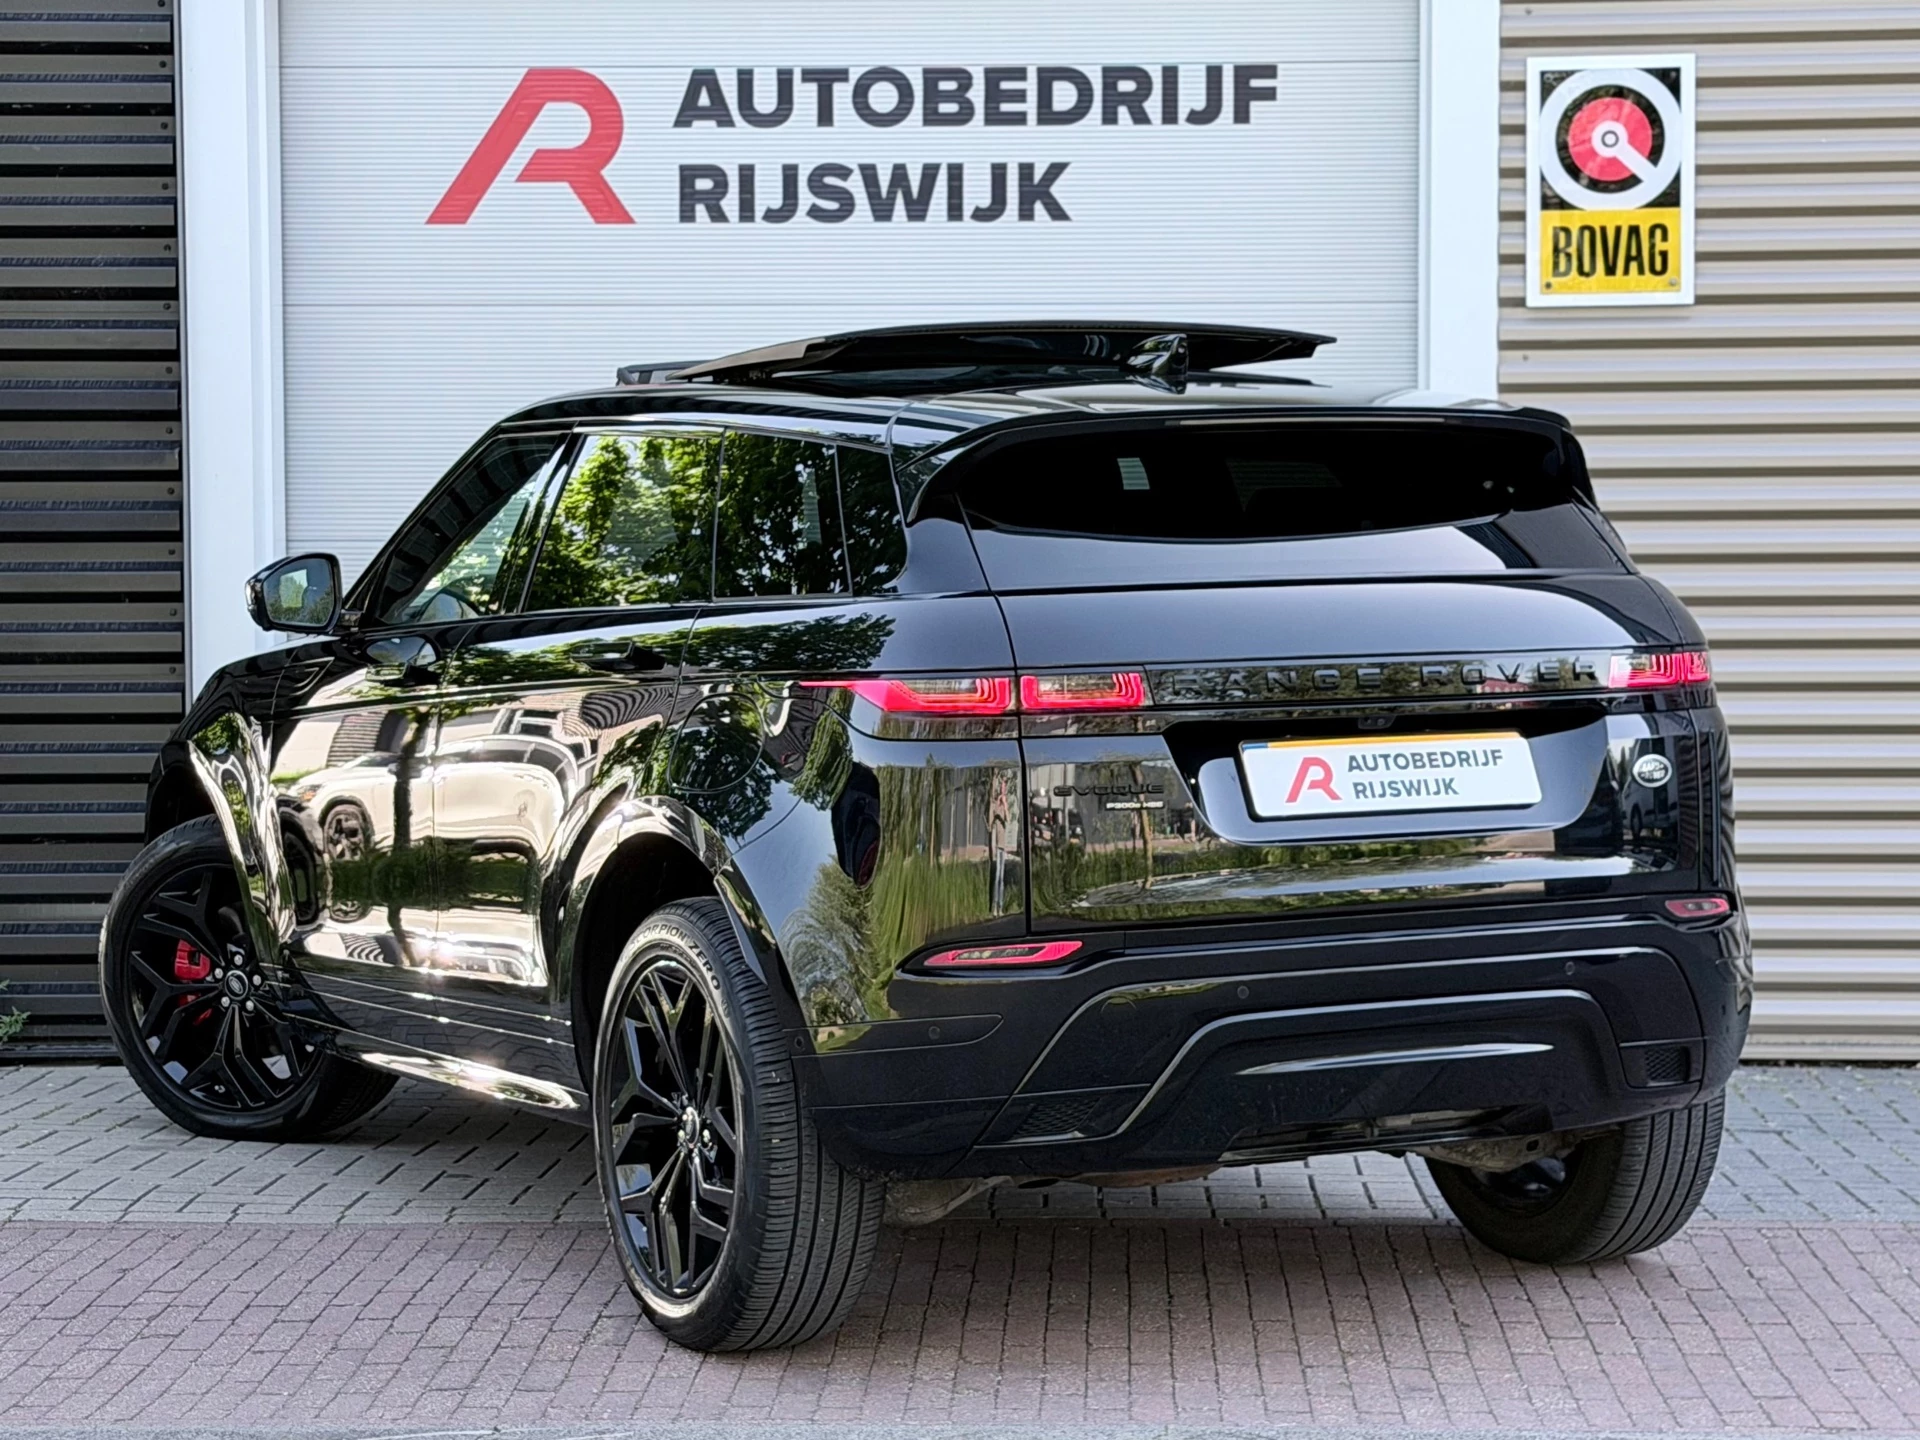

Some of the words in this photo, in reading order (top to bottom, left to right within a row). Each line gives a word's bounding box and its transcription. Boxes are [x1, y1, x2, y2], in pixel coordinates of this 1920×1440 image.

[672, 64, 1279, 128] AUTOBEDRIJF
[678, 162, 1072, 224] RIJSWIJK
[1552, 223, 1669, 278] BOVAG
[1172, 666, 1383, 697] RANGE
[1420, 658, 1600, 686] ROVER
[1347, 749, 1504, 773] AUTOBEDRIJF
[1053, 783, 1165, 797] EVOQUE
[1352, 777, 1460, 800] RIJSWIJK
[688, 940, 721, 991] ZERO
